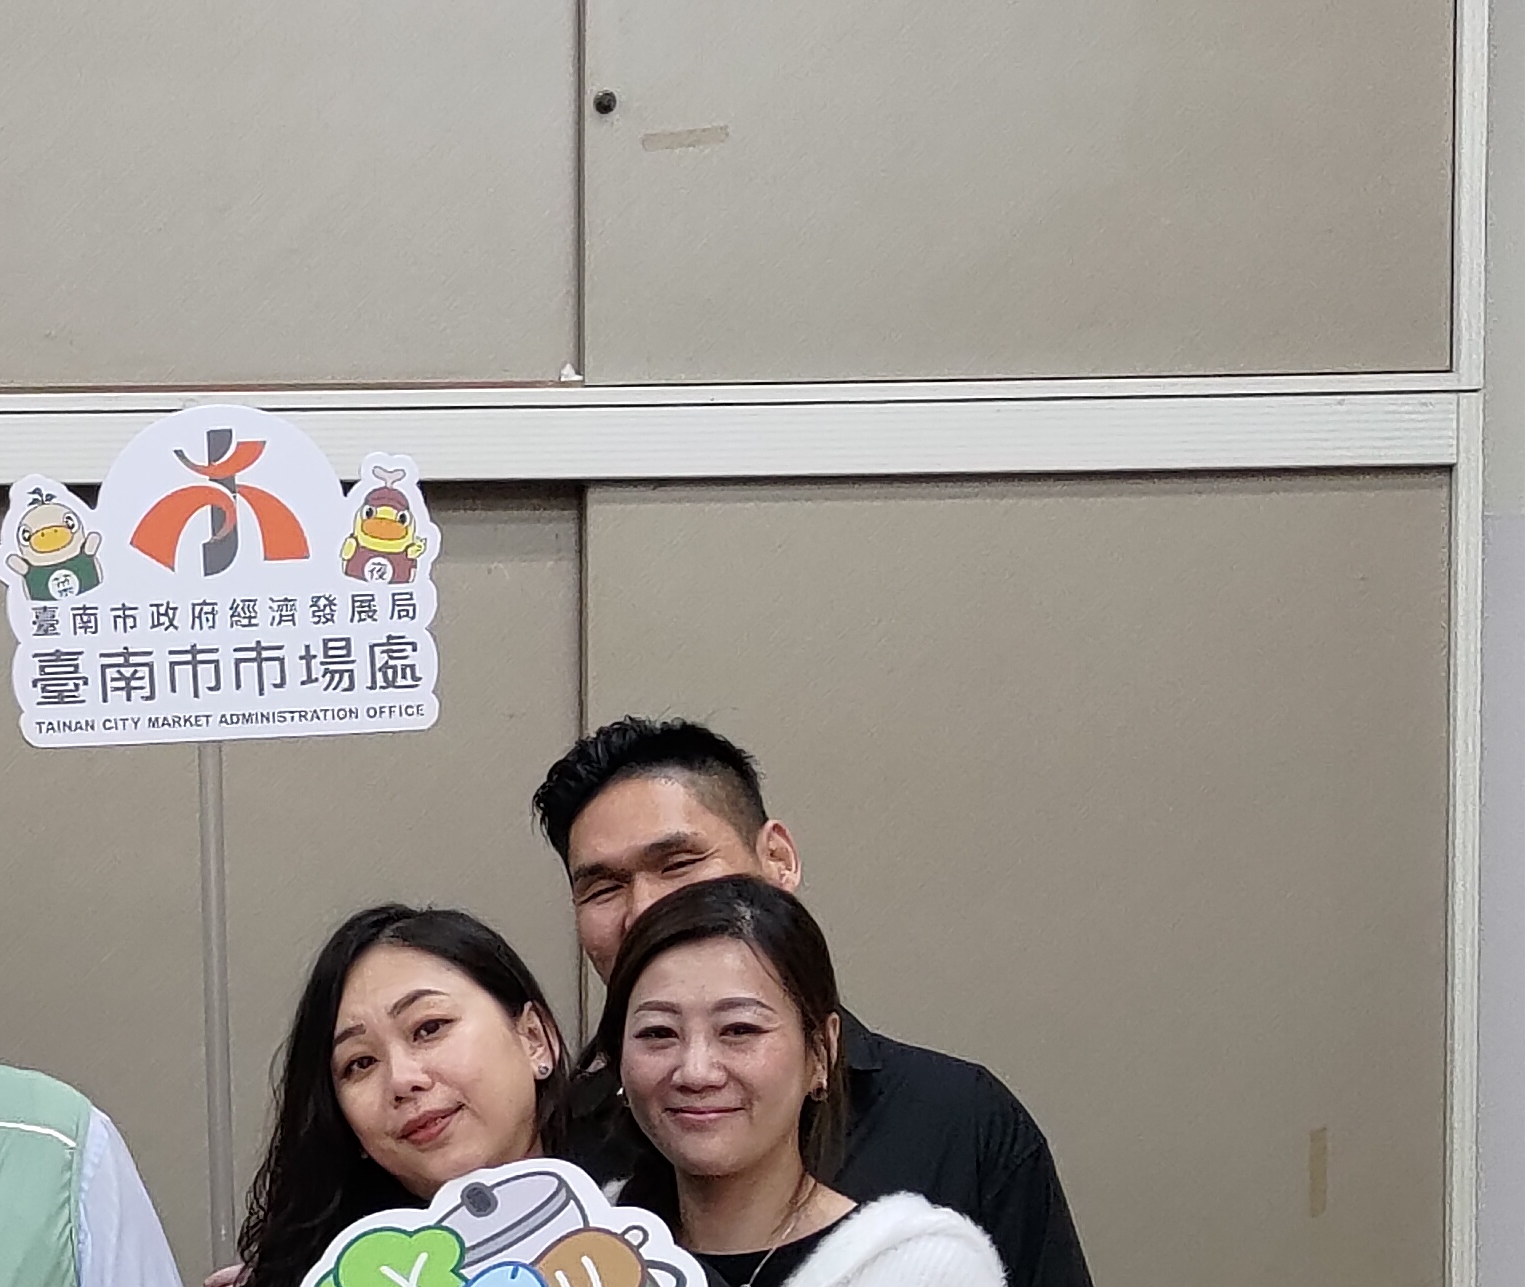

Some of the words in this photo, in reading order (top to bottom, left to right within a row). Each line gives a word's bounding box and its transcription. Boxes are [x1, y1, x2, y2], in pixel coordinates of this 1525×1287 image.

[31, 592, 417, 637] 臺南市政府經濟發展局
[31, 634, 423, 707] 臺南市市場處
[36, 719, 96, 735] TAINAN
[102, 716, 142, 731] CITY
[148, 713, 213, 730] MARKET
[219, 706, 359, 728] ADMINISTRATION
[366, 703, 426, 719] OFFICE
